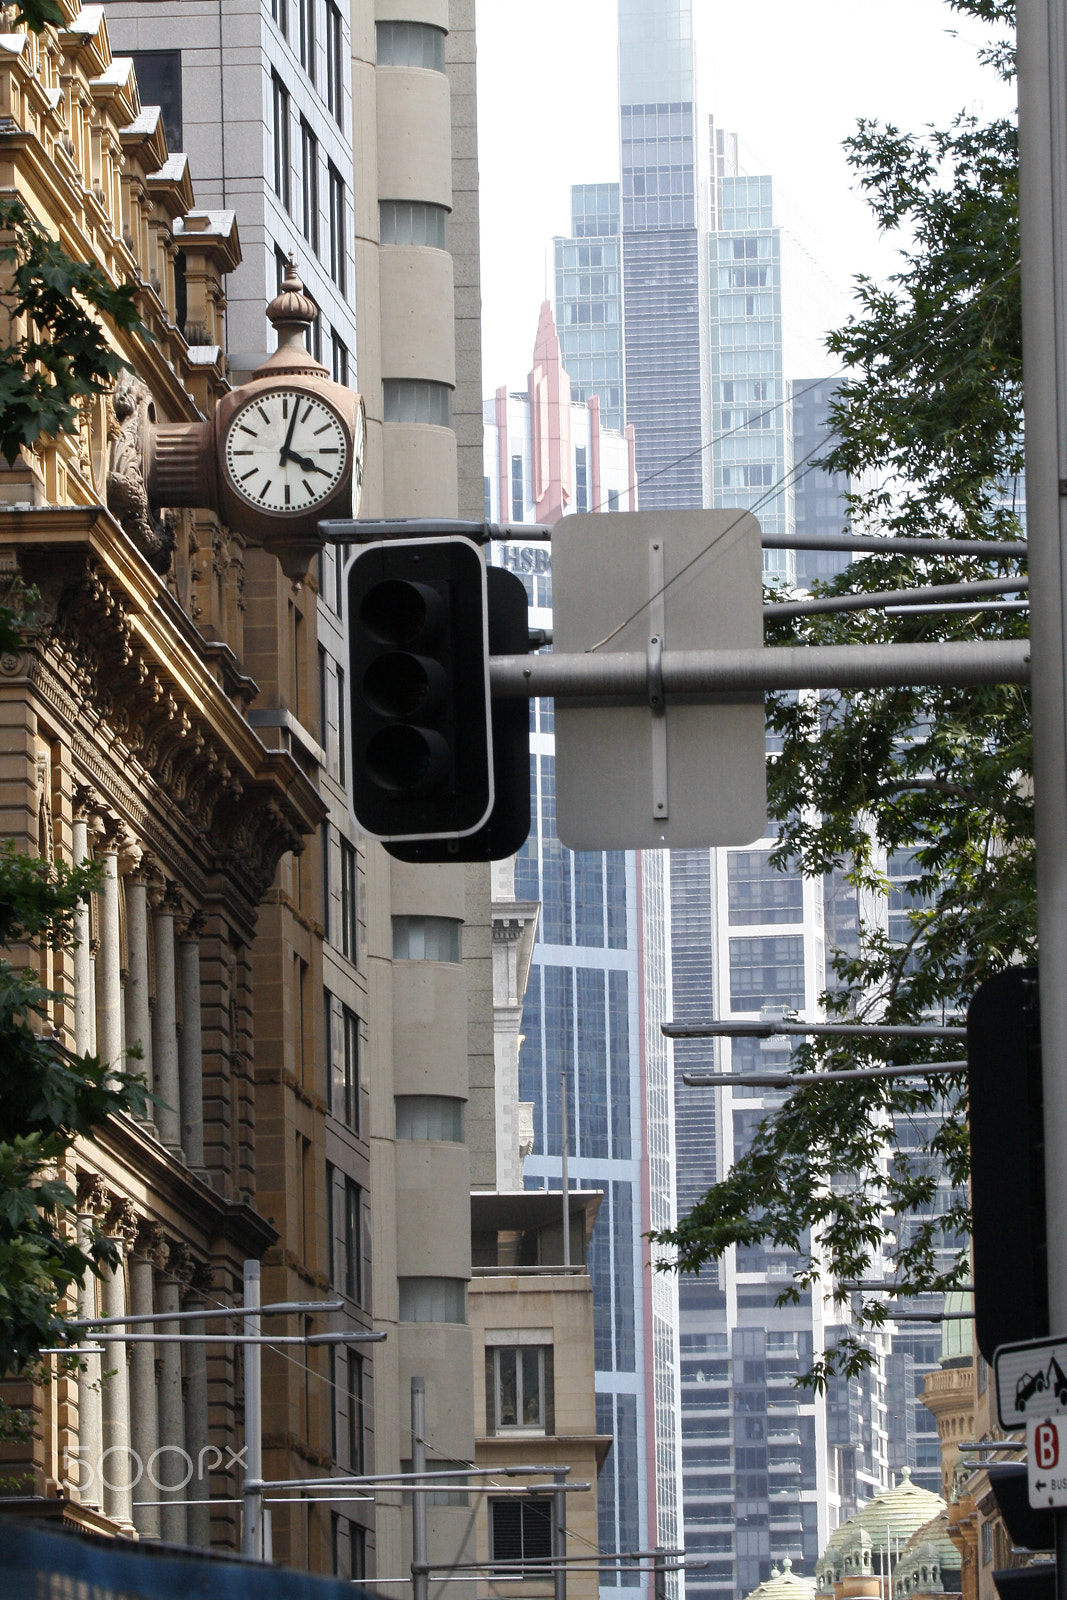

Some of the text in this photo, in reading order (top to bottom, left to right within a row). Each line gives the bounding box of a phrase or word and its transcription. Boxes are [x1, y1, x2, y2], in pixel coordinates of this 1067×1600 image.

[502, 545, 551, 573] HSB
[1039, 1426, 1056, 1467] B
[1051, 1478, 1067, 1490] BUS
